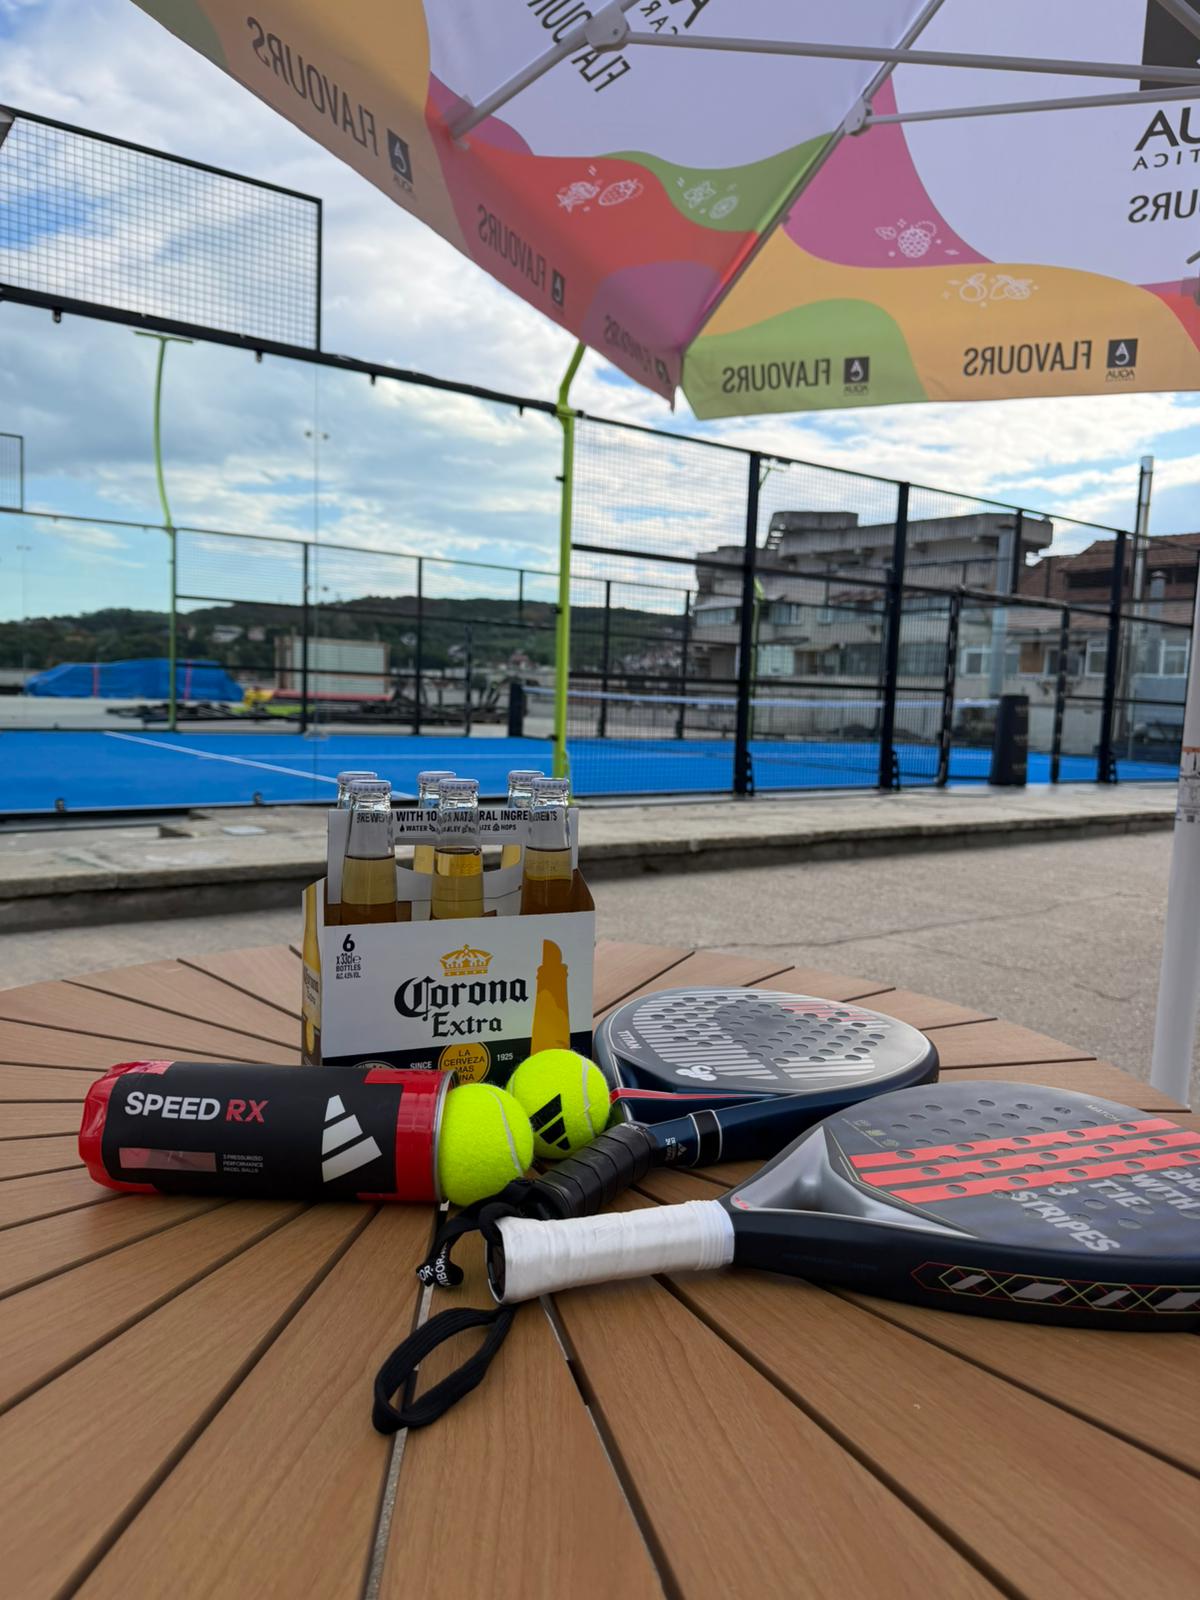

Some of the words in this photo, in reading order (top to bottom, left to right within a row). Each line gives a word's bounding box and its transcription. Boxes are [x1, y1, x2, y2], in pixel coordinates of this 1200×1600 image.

[397, 811, 423, 821] WITH
[343, 934, 355, 952] 6
[336, 964, 361, 972] BOTTLES
[394, 976, 528, 1022] Corona
[432, 1011, 502, 1038] Extra
[458, 1049, 471, 1057] LA
[497, 1053, 514, 1062] 1925
[410, 1061, 432, 1069] SINCE
[444, 1056, 485, 1067] CERVEZA
[124, 1091, 221, 1121] SPEED
[225, 1099, 269, 1123] RX
[1048, 1187, 1079, 1196] 3
[1011, 1191, 1121, 1251] STRIPES
